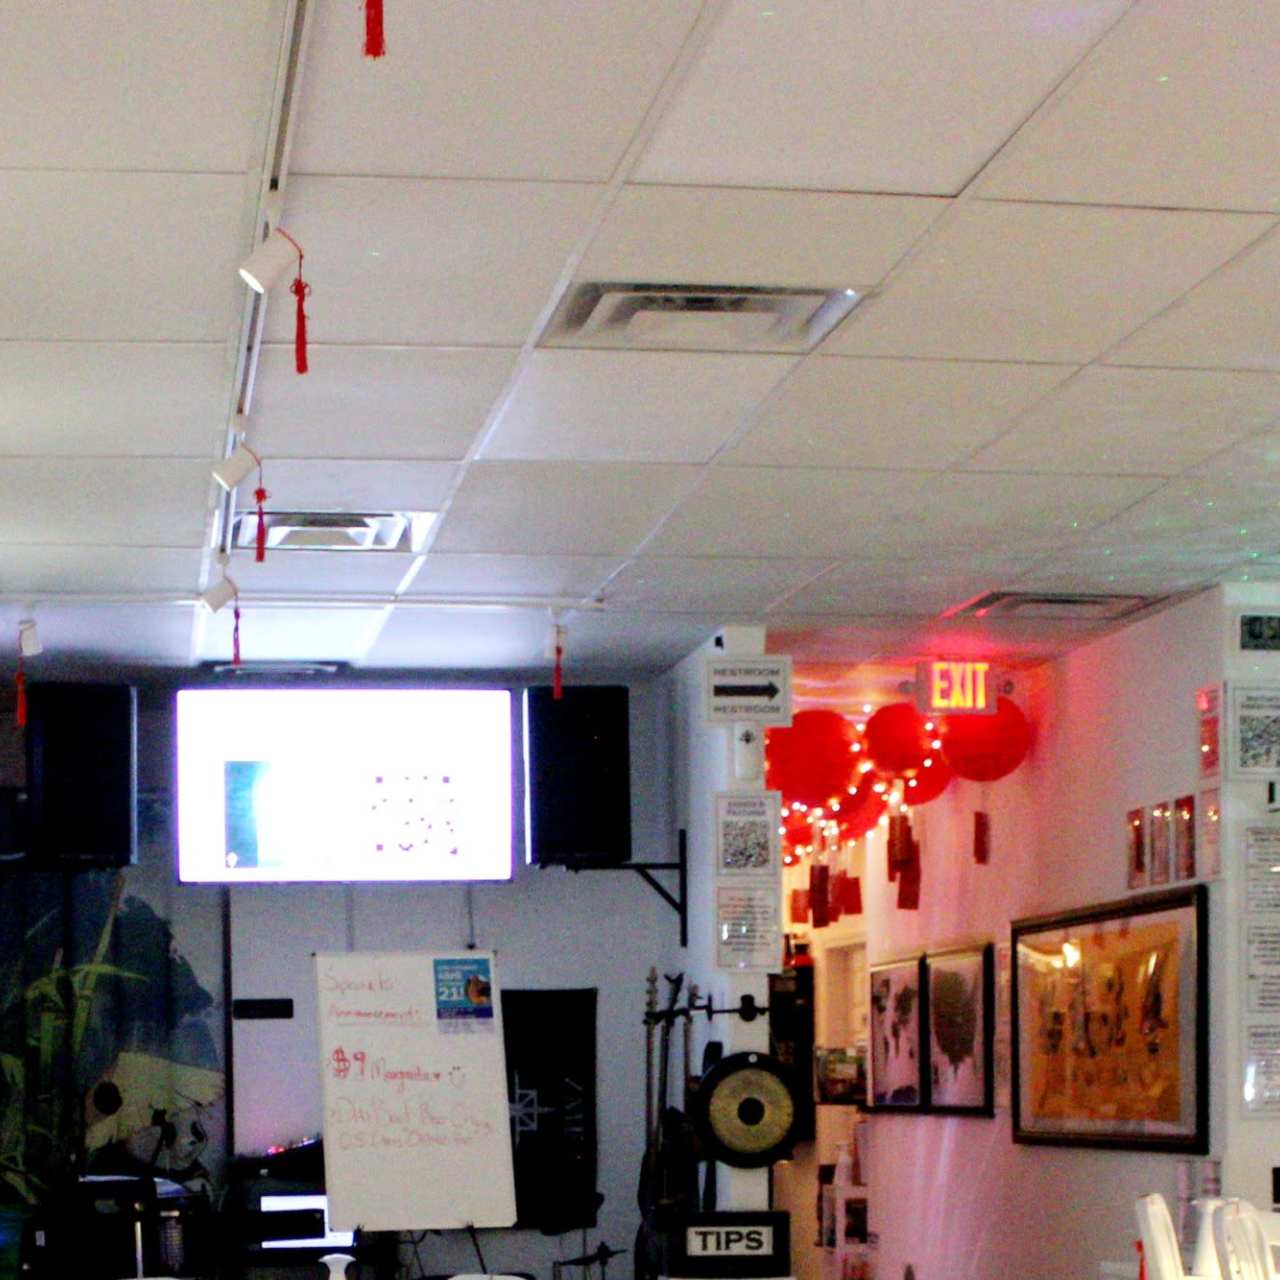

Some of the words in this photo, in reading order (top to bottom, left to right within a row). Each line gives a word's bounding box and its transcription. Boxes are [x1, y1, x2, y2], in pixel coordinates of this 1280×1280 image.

[713, 667, 780, 677] RESTROOM
[931, 661, 990, 709] EXIT
[713, 704, 781, 714] RESTROOM
[694, 1230, 764, 1251] TIPS
